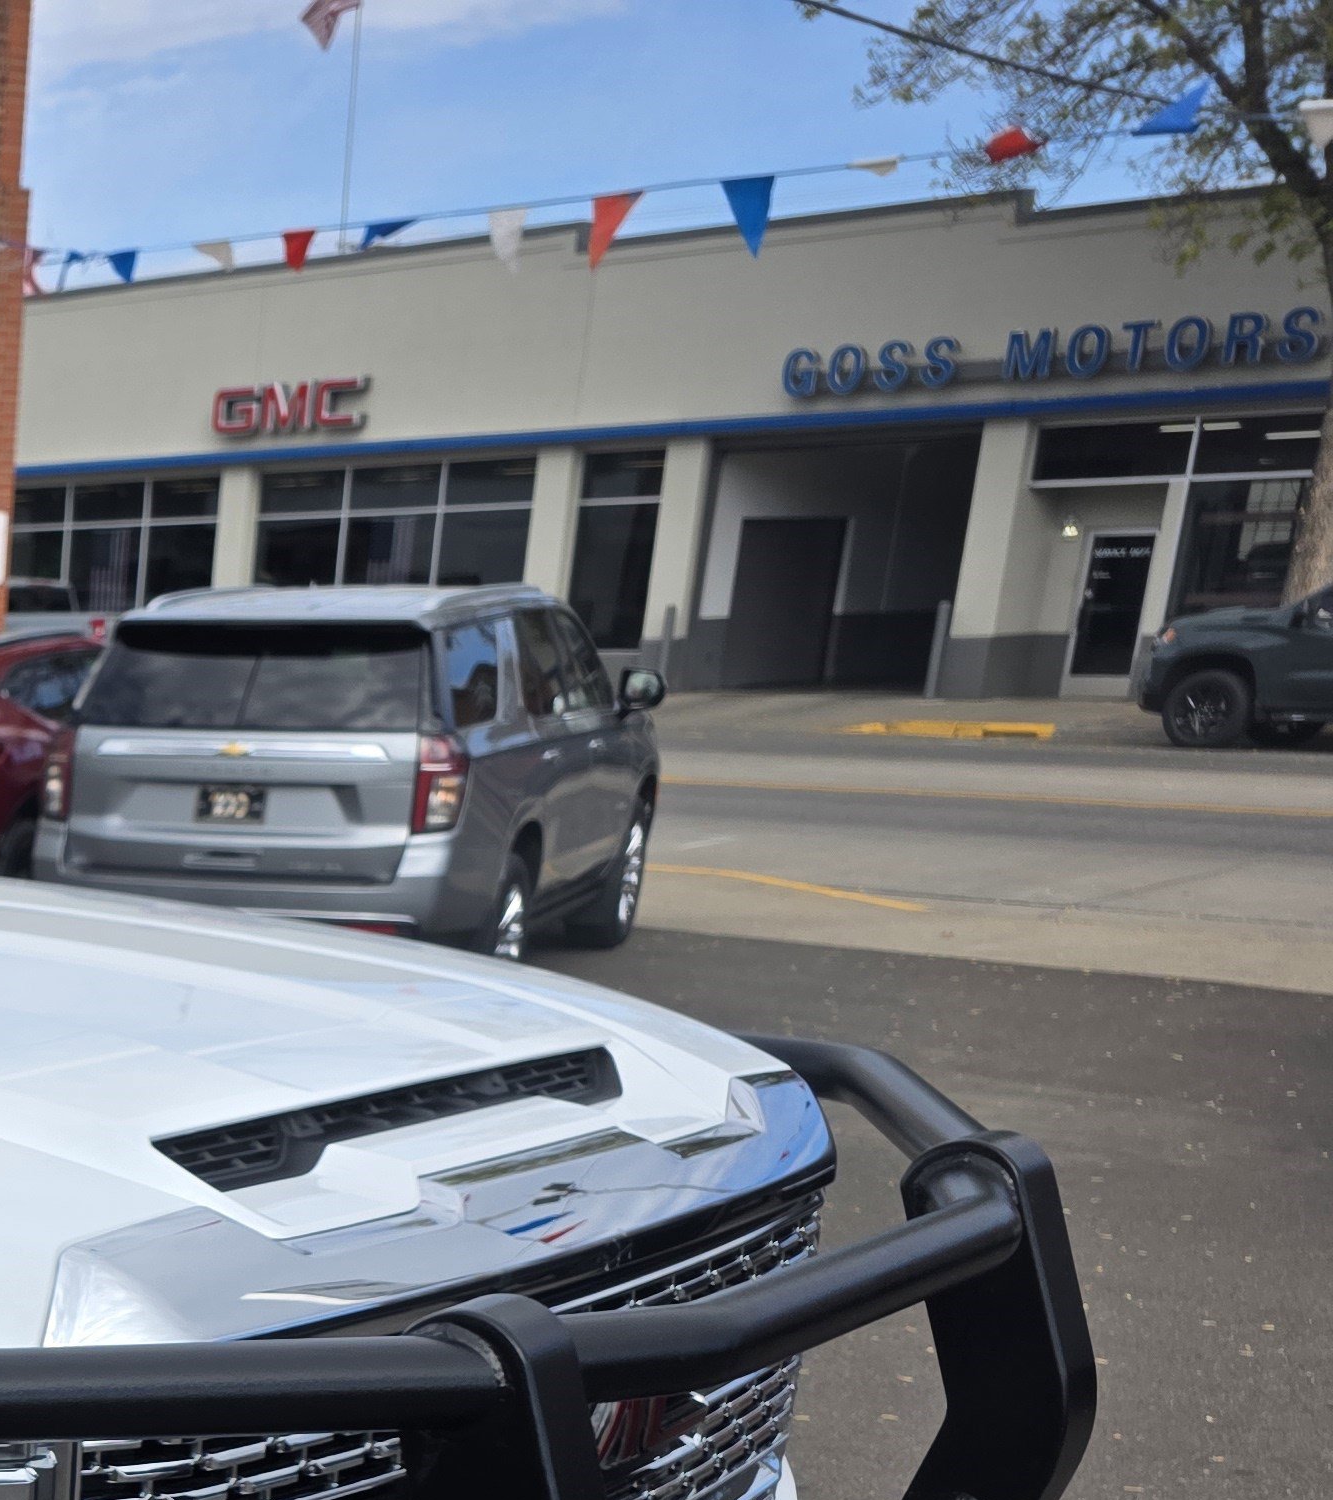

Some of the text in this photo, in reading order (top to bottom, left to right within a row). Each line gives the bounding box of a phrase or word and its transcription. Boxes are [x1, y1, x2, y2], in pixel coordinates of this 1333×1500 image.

[781, 306, 1324, 398] GOSS MOTORS
[213, 376, 365, 435] GMC
